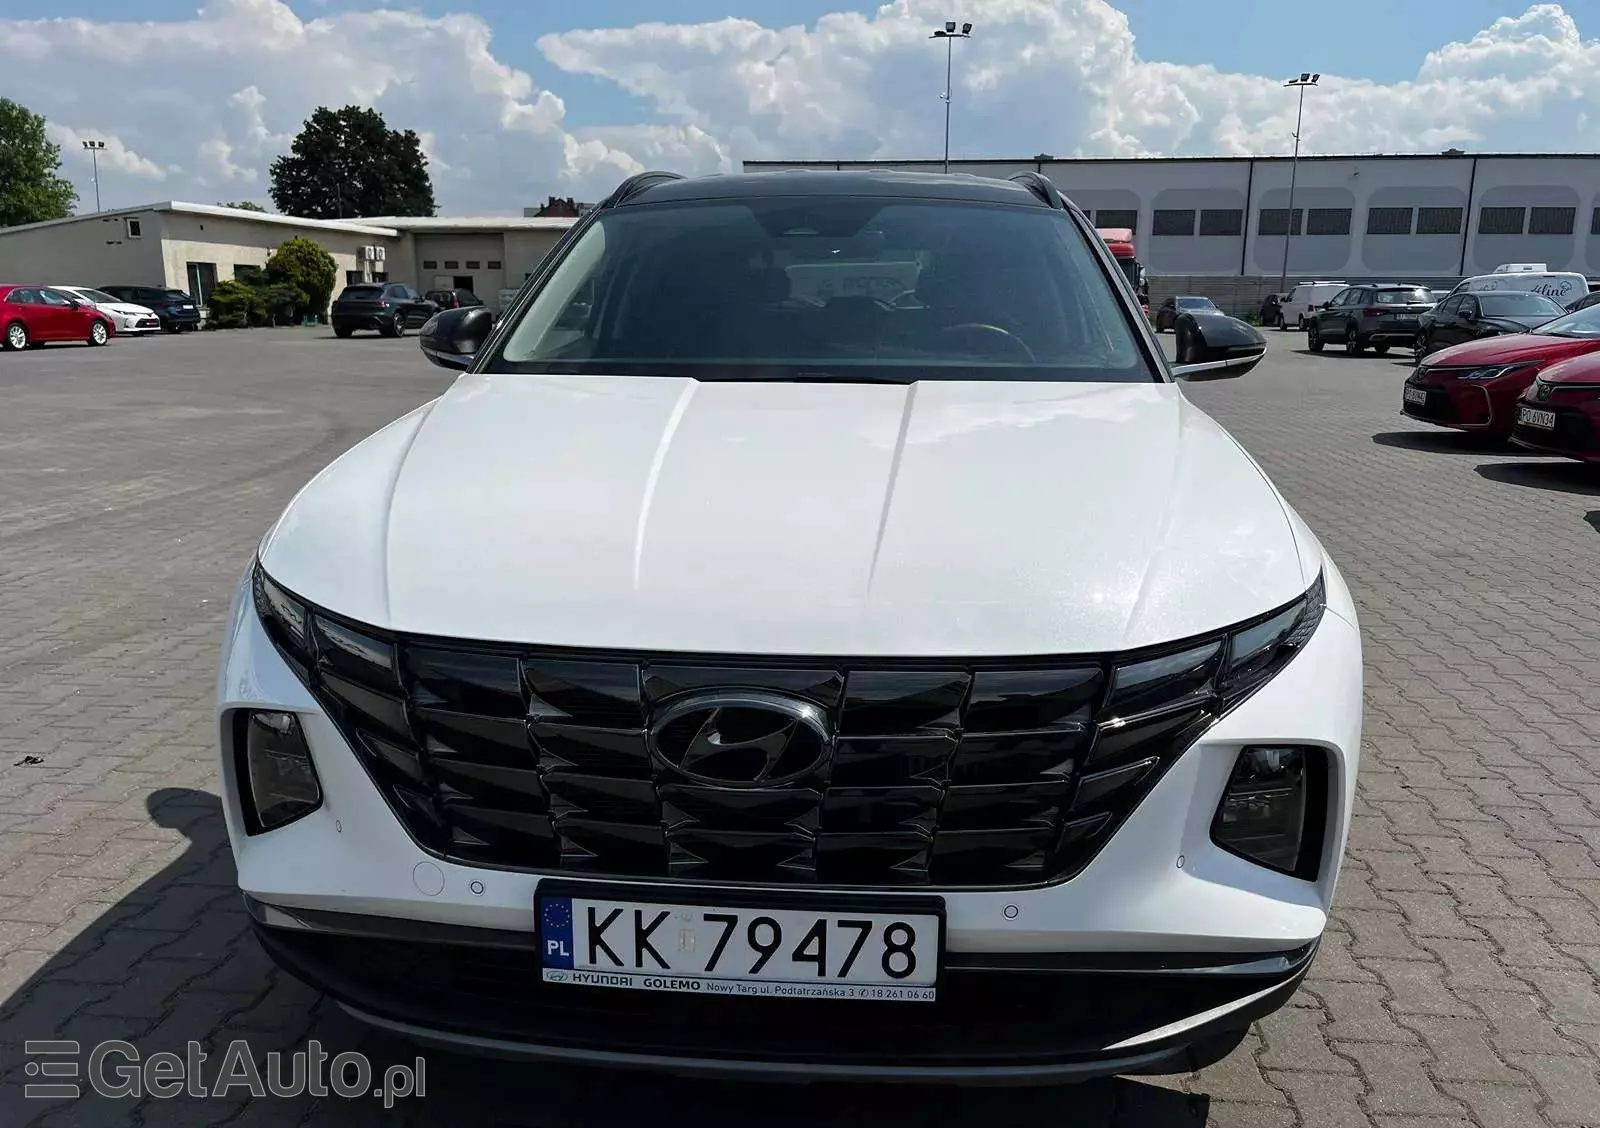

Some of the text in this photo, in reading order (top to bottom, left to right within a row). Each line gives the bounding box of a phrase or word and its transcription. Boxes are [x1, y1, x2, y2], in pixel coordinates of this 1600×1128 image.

[546, 939, 569, 956] PL
[587, 906, 917, 978] KK 79478
[572, 973, 633, 987] HYUNDAI
[643, 978, 701, 990] GOLEMO
[706, 983, 734, 993] Nowy
[737, 984, 757, 995] Targ
[760, 986, 772, 994] ul.
[848, 988, 855, 997] 3
[872, 988, 883, 997] 18
[886, 990, 903, 999] 261
[907, 990, 919, 999] 06
[922, 991, 934, 999] 60
